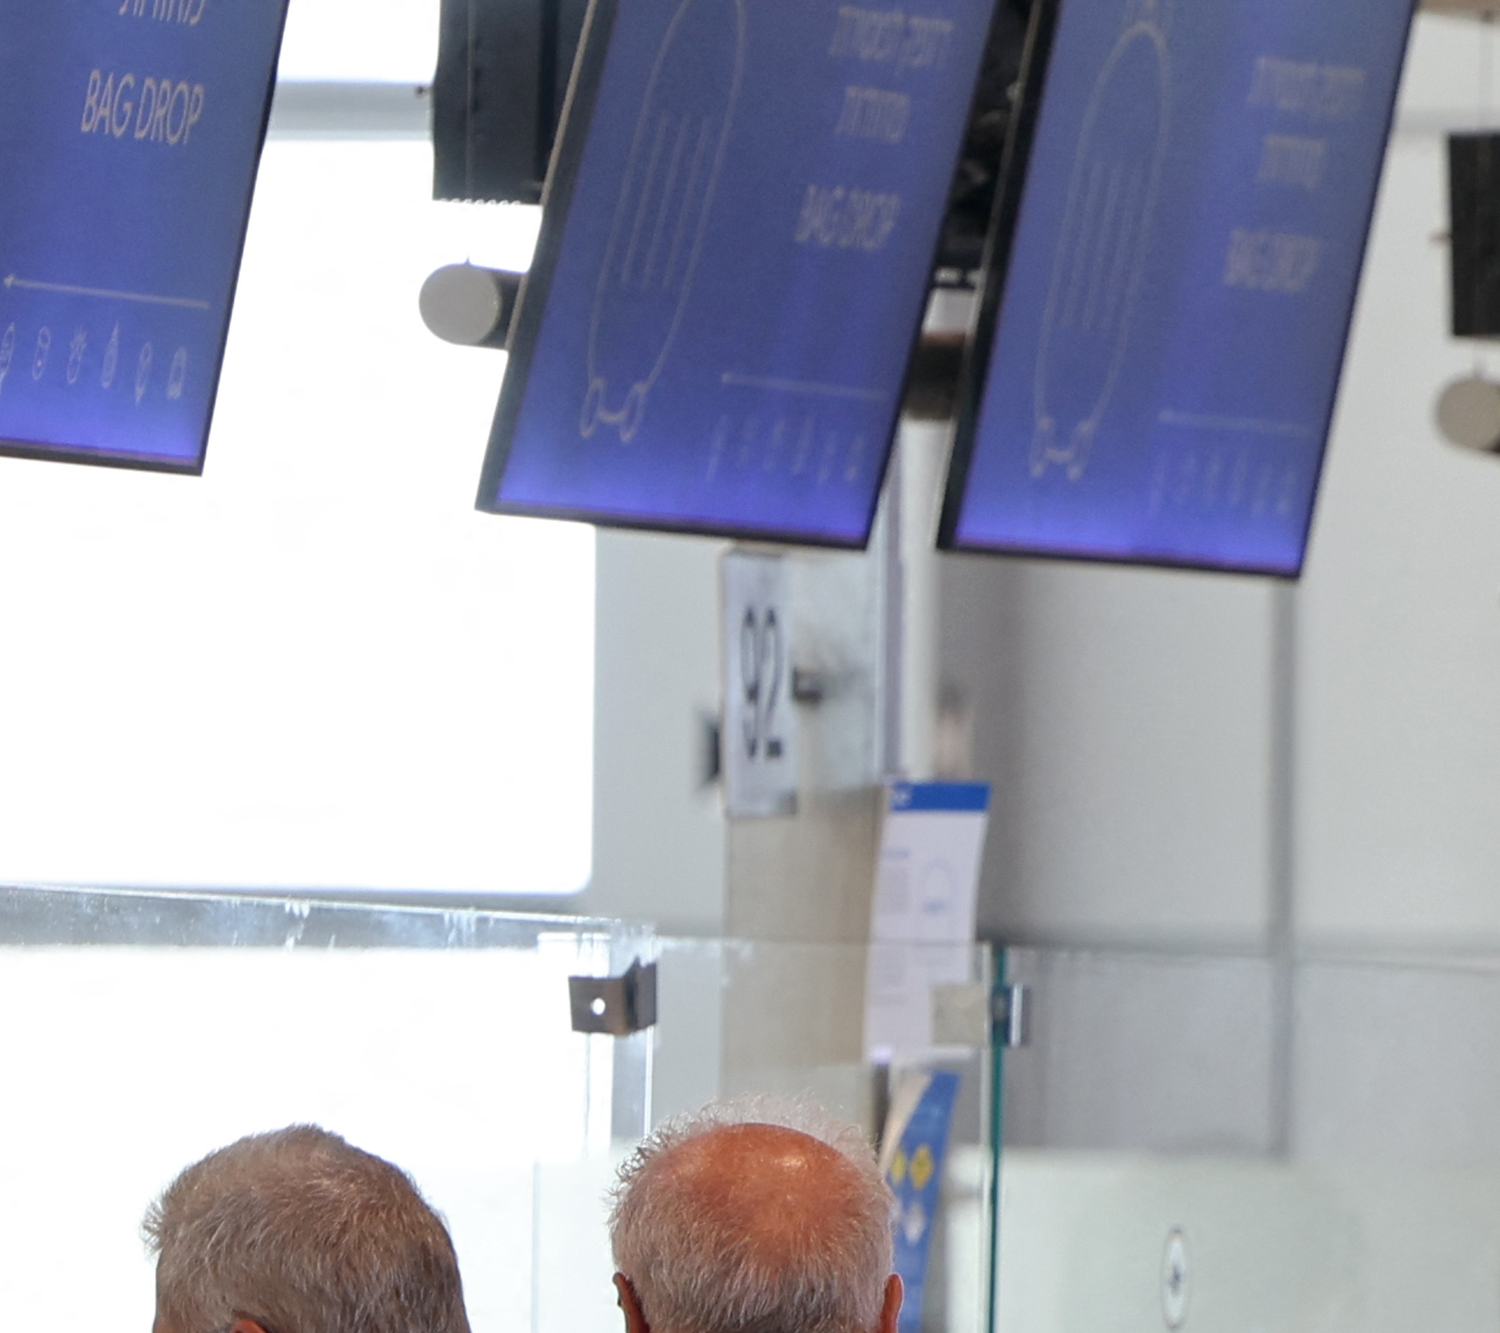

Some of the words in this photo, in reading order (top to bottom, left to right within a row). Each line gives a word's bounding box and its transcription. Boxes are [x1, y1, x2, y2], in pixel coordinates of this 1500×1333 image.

[80, 68, 136, 138] BAG
[133, 76, 205, 146] DROP
[739, 606, 785, 760] 92
